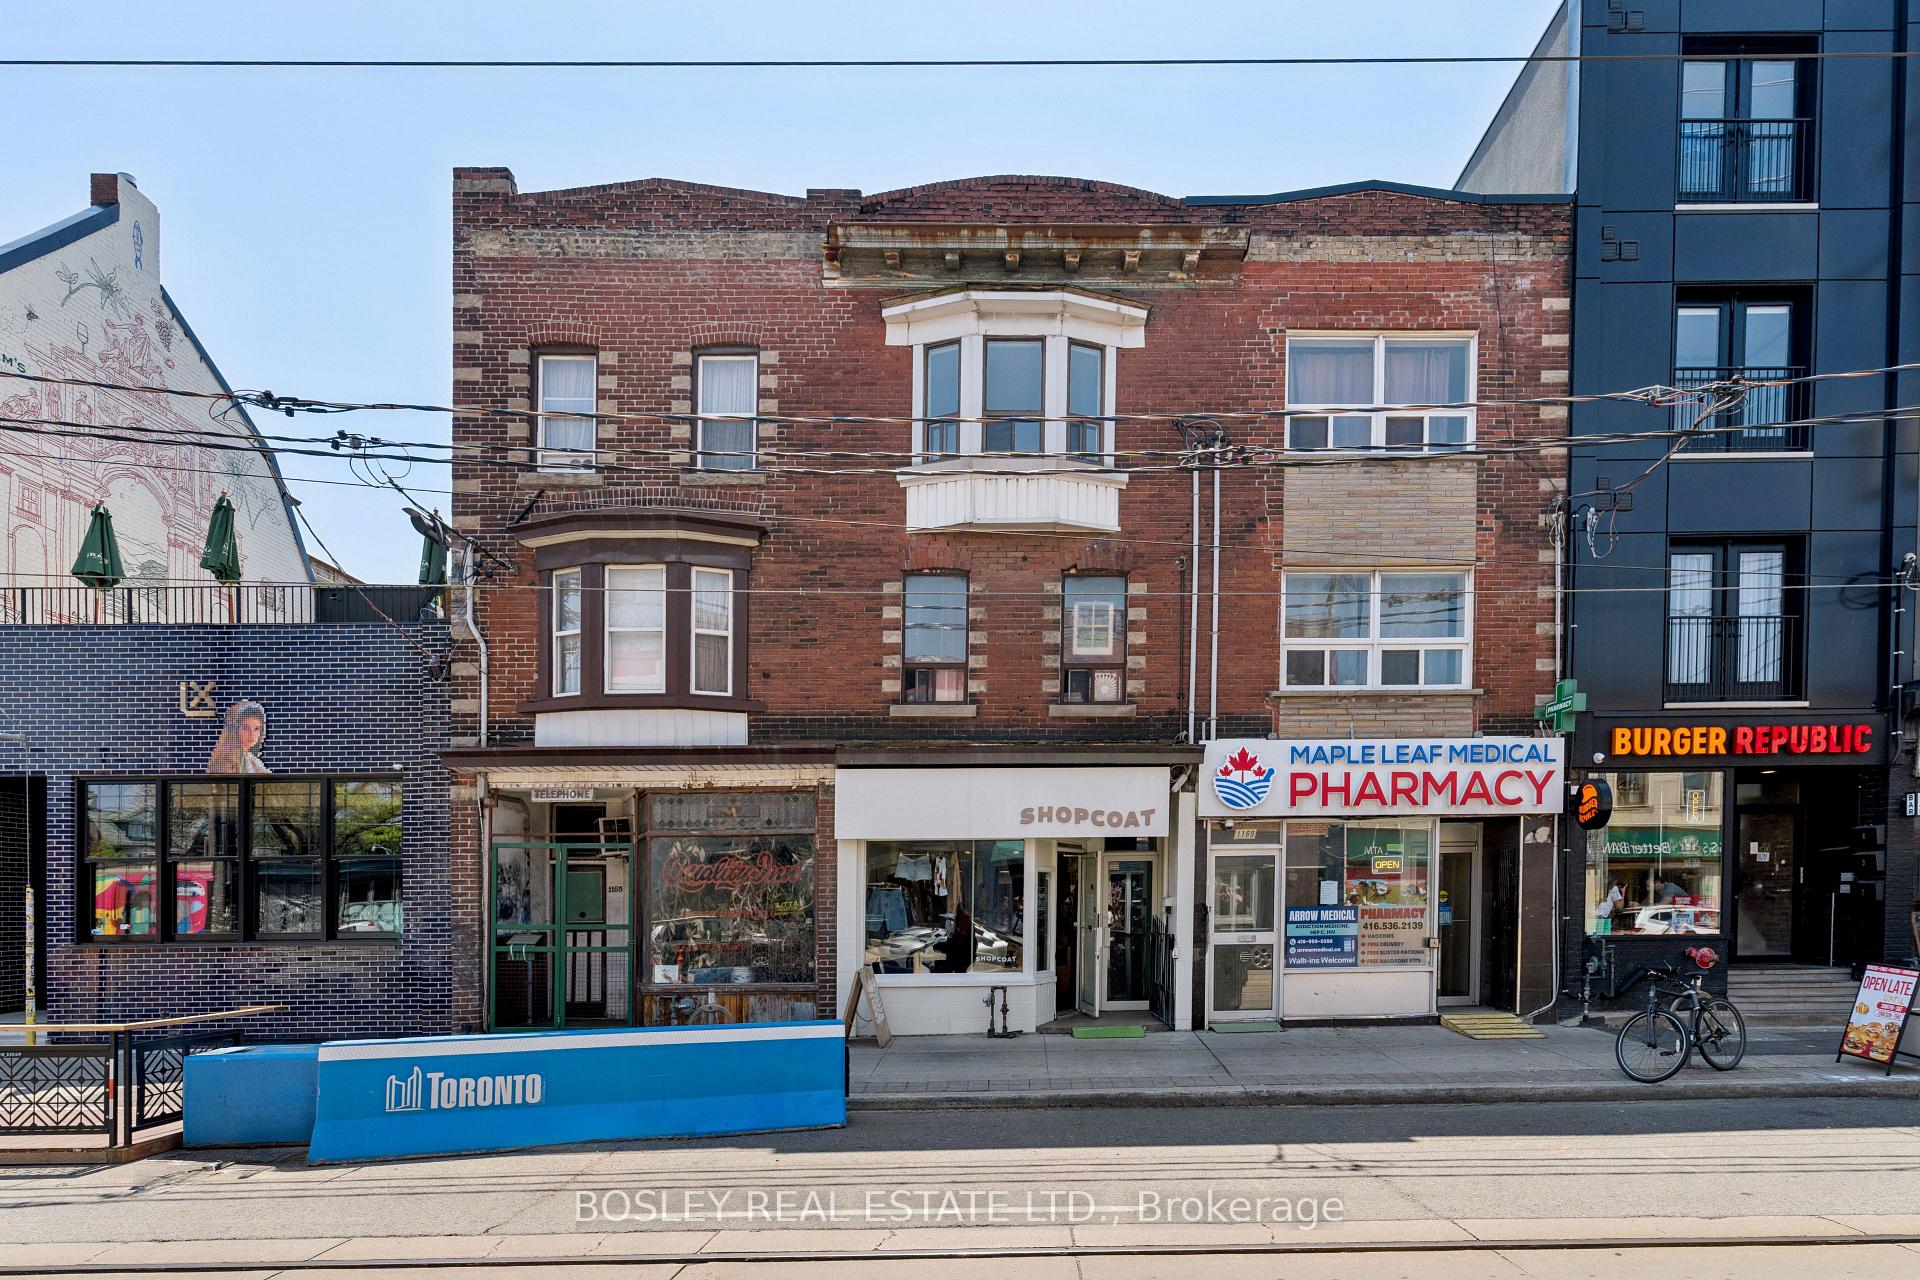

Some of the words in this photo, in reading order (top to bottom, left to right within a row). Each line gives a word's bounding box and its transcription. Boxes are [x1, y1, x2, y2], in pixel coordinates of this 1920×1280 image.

[1547, 700, 1572, 713] PHARMACY
[1612, 727, 1727, 756] BURGER
[1733, 725, 1872, 754] REPUBLIC
[1290, 745, 1375, 765] MAPLE
[1381, 744, 1443, 764] LEAF
[1448, 743, 1557, 763] MEDICAL
[534, 790, 590, 799] TELEPHONE
[1289, 770, 1556, 807] PHARMACY
[1691, 791, 1699, 821] OPEN
[1019, 806, 1156, 828] SHOPCOAT
[1236, 830, 1256, 838] 1169
[1375, 860, 1400, 869] OPEN
[608, 885, 623, 893] 1165
[1289, 910, 1319, 921] ARROW
[1320, 909, 1356, 921] MEDICAL
[1360, 908, 1426, 919] PHARMACY
[1362, 921, 1423, 931] 416.536.2139
[975, 955, 1017, 963] SHOPCOAT
[1289, 957, 1320, 965] Walk-ins
[1321, 956, 1356, 964] Welcome!
[1863, 976, 1888, 992] OPEN
[427, 1072, 542, 1110] TORONTO
